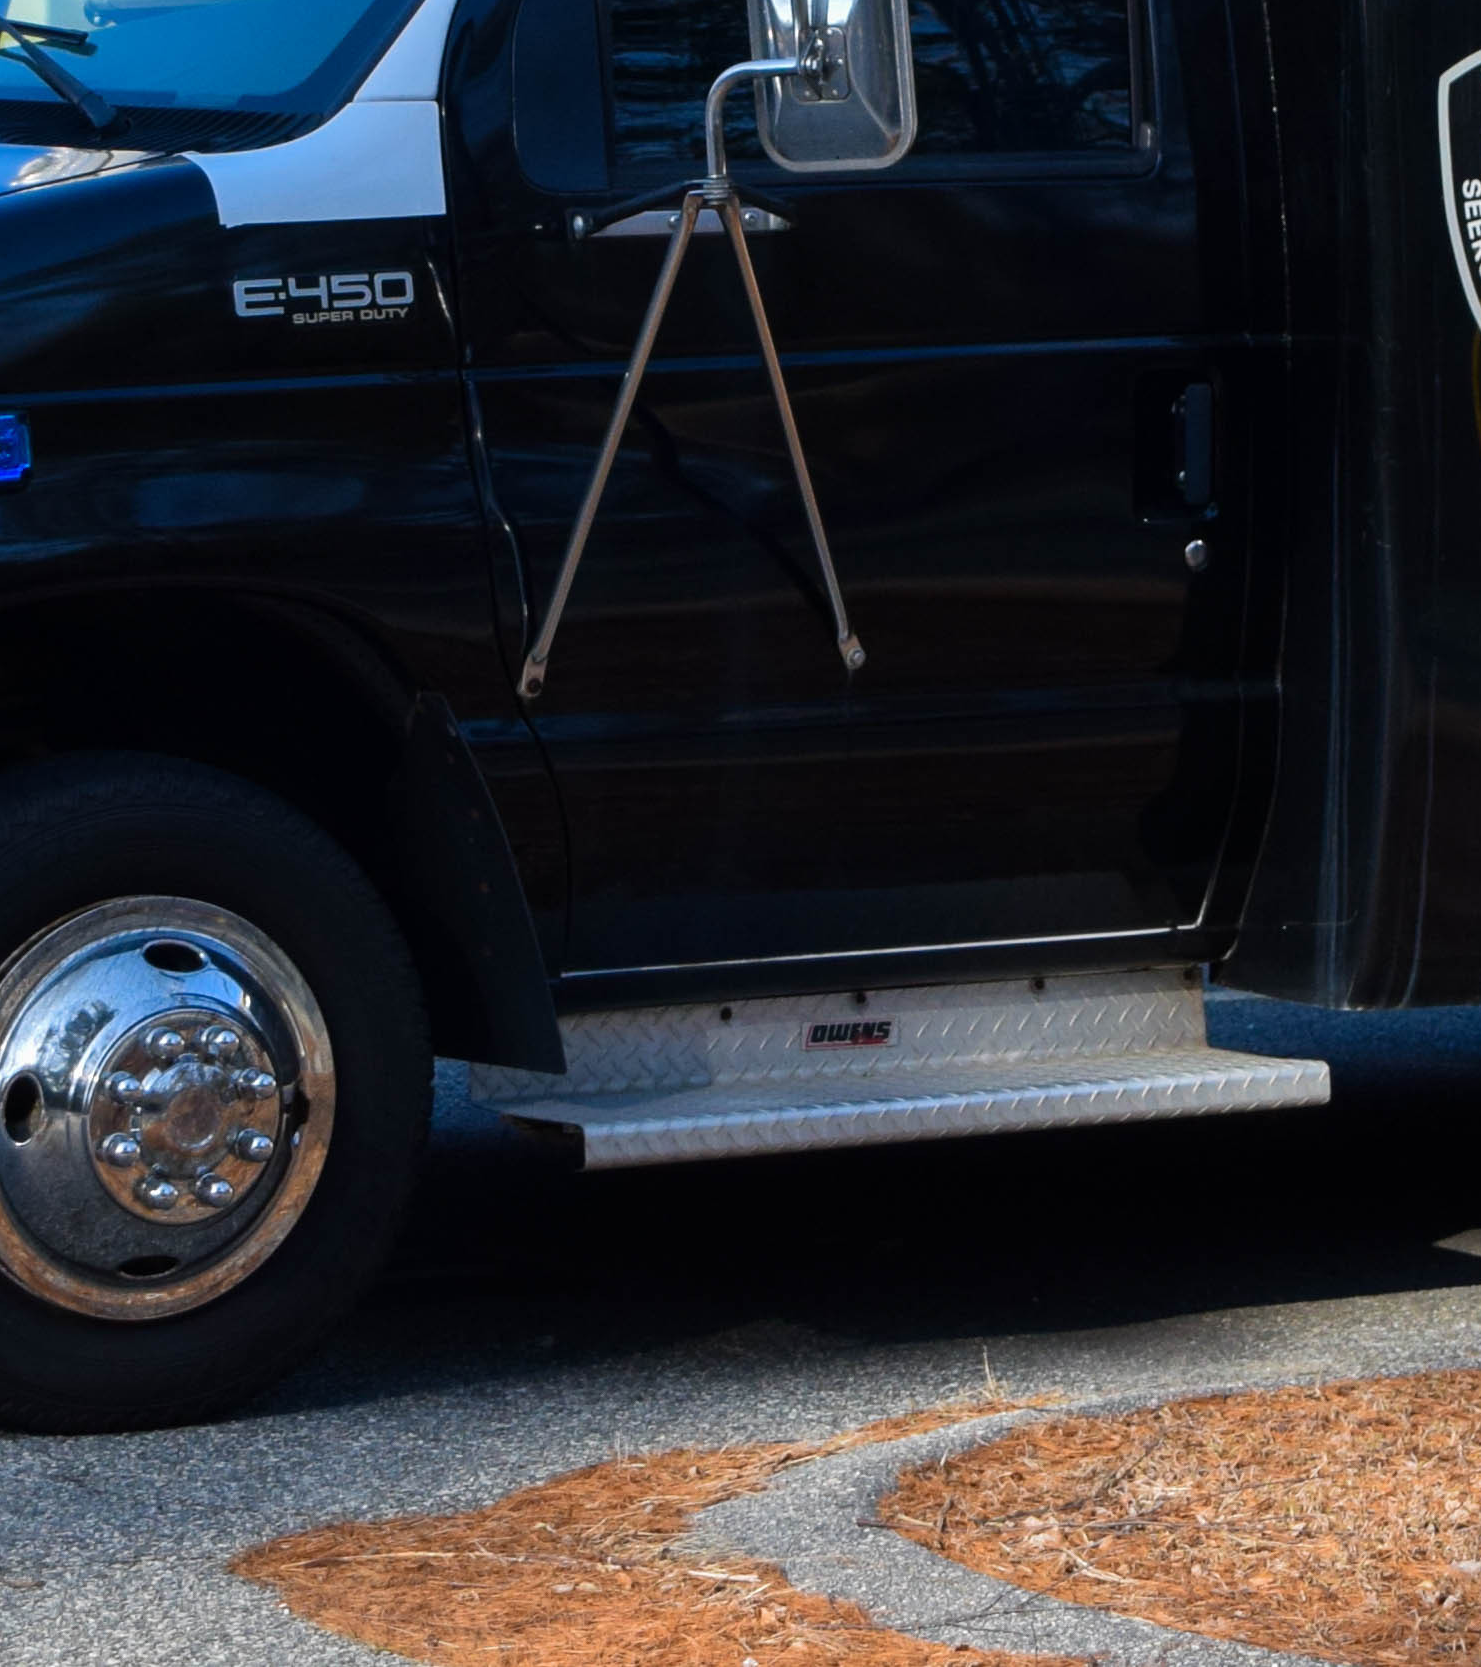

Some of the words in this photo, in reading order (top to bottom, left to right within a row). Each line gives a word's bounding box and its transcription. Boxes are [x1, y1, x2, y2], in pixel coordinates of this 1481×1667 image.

[292, 310, 354, 324] SUPER
[360, 307, 409, 320] DUTY
[810, 1021, 892, 1043] OWENS
